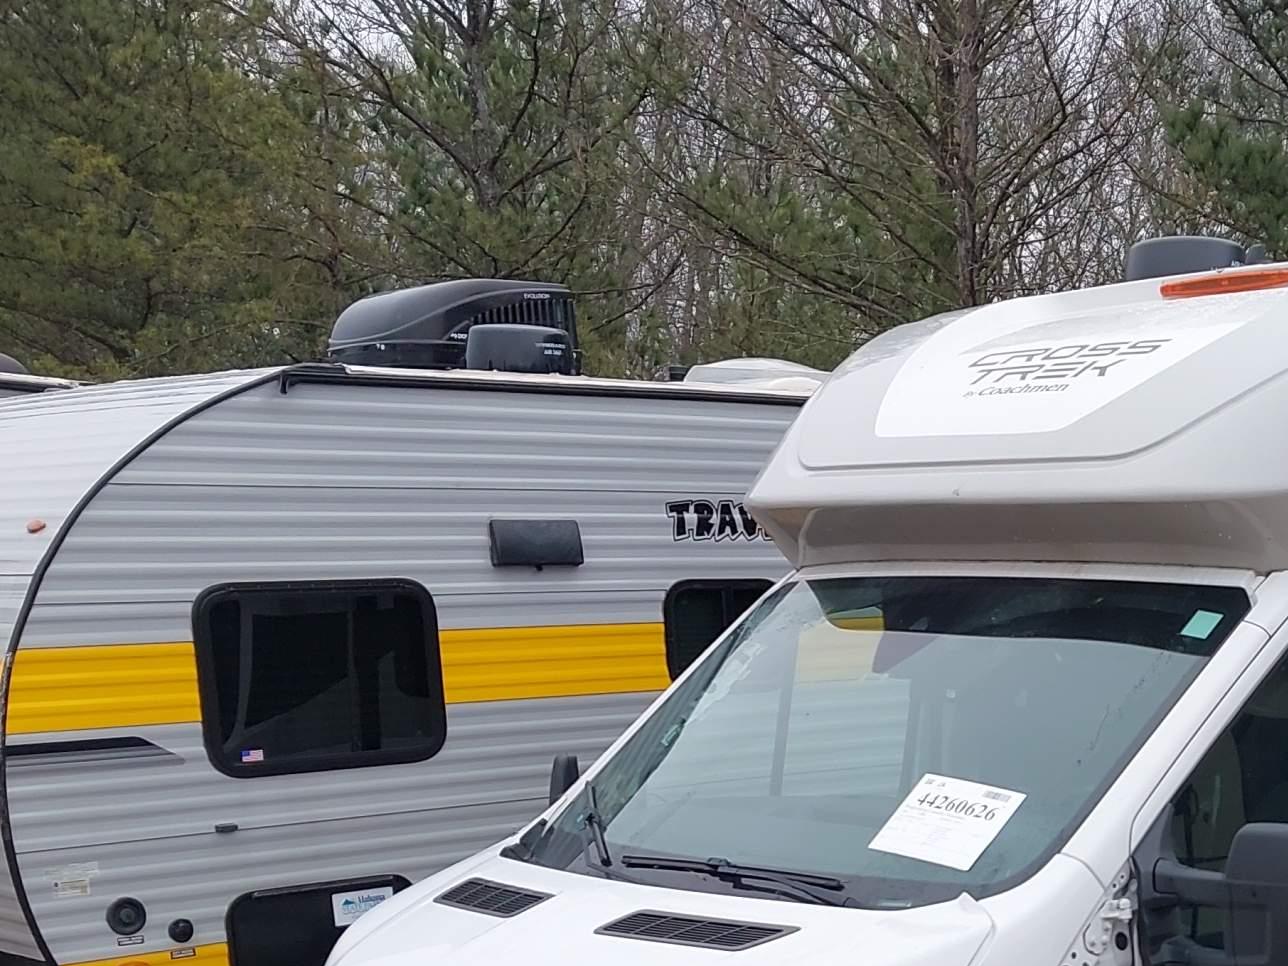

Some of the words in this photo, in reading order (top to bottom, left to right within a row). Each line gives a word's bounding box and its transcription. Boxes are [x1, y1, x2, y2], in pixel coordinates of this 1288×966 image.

[968, 338, 1173, 368] CROSS
[970, 358, 1127, 386] TREK
[978, 382, 1070, 397] Coachmen
[917, 792, 1000, 821] 44260626
